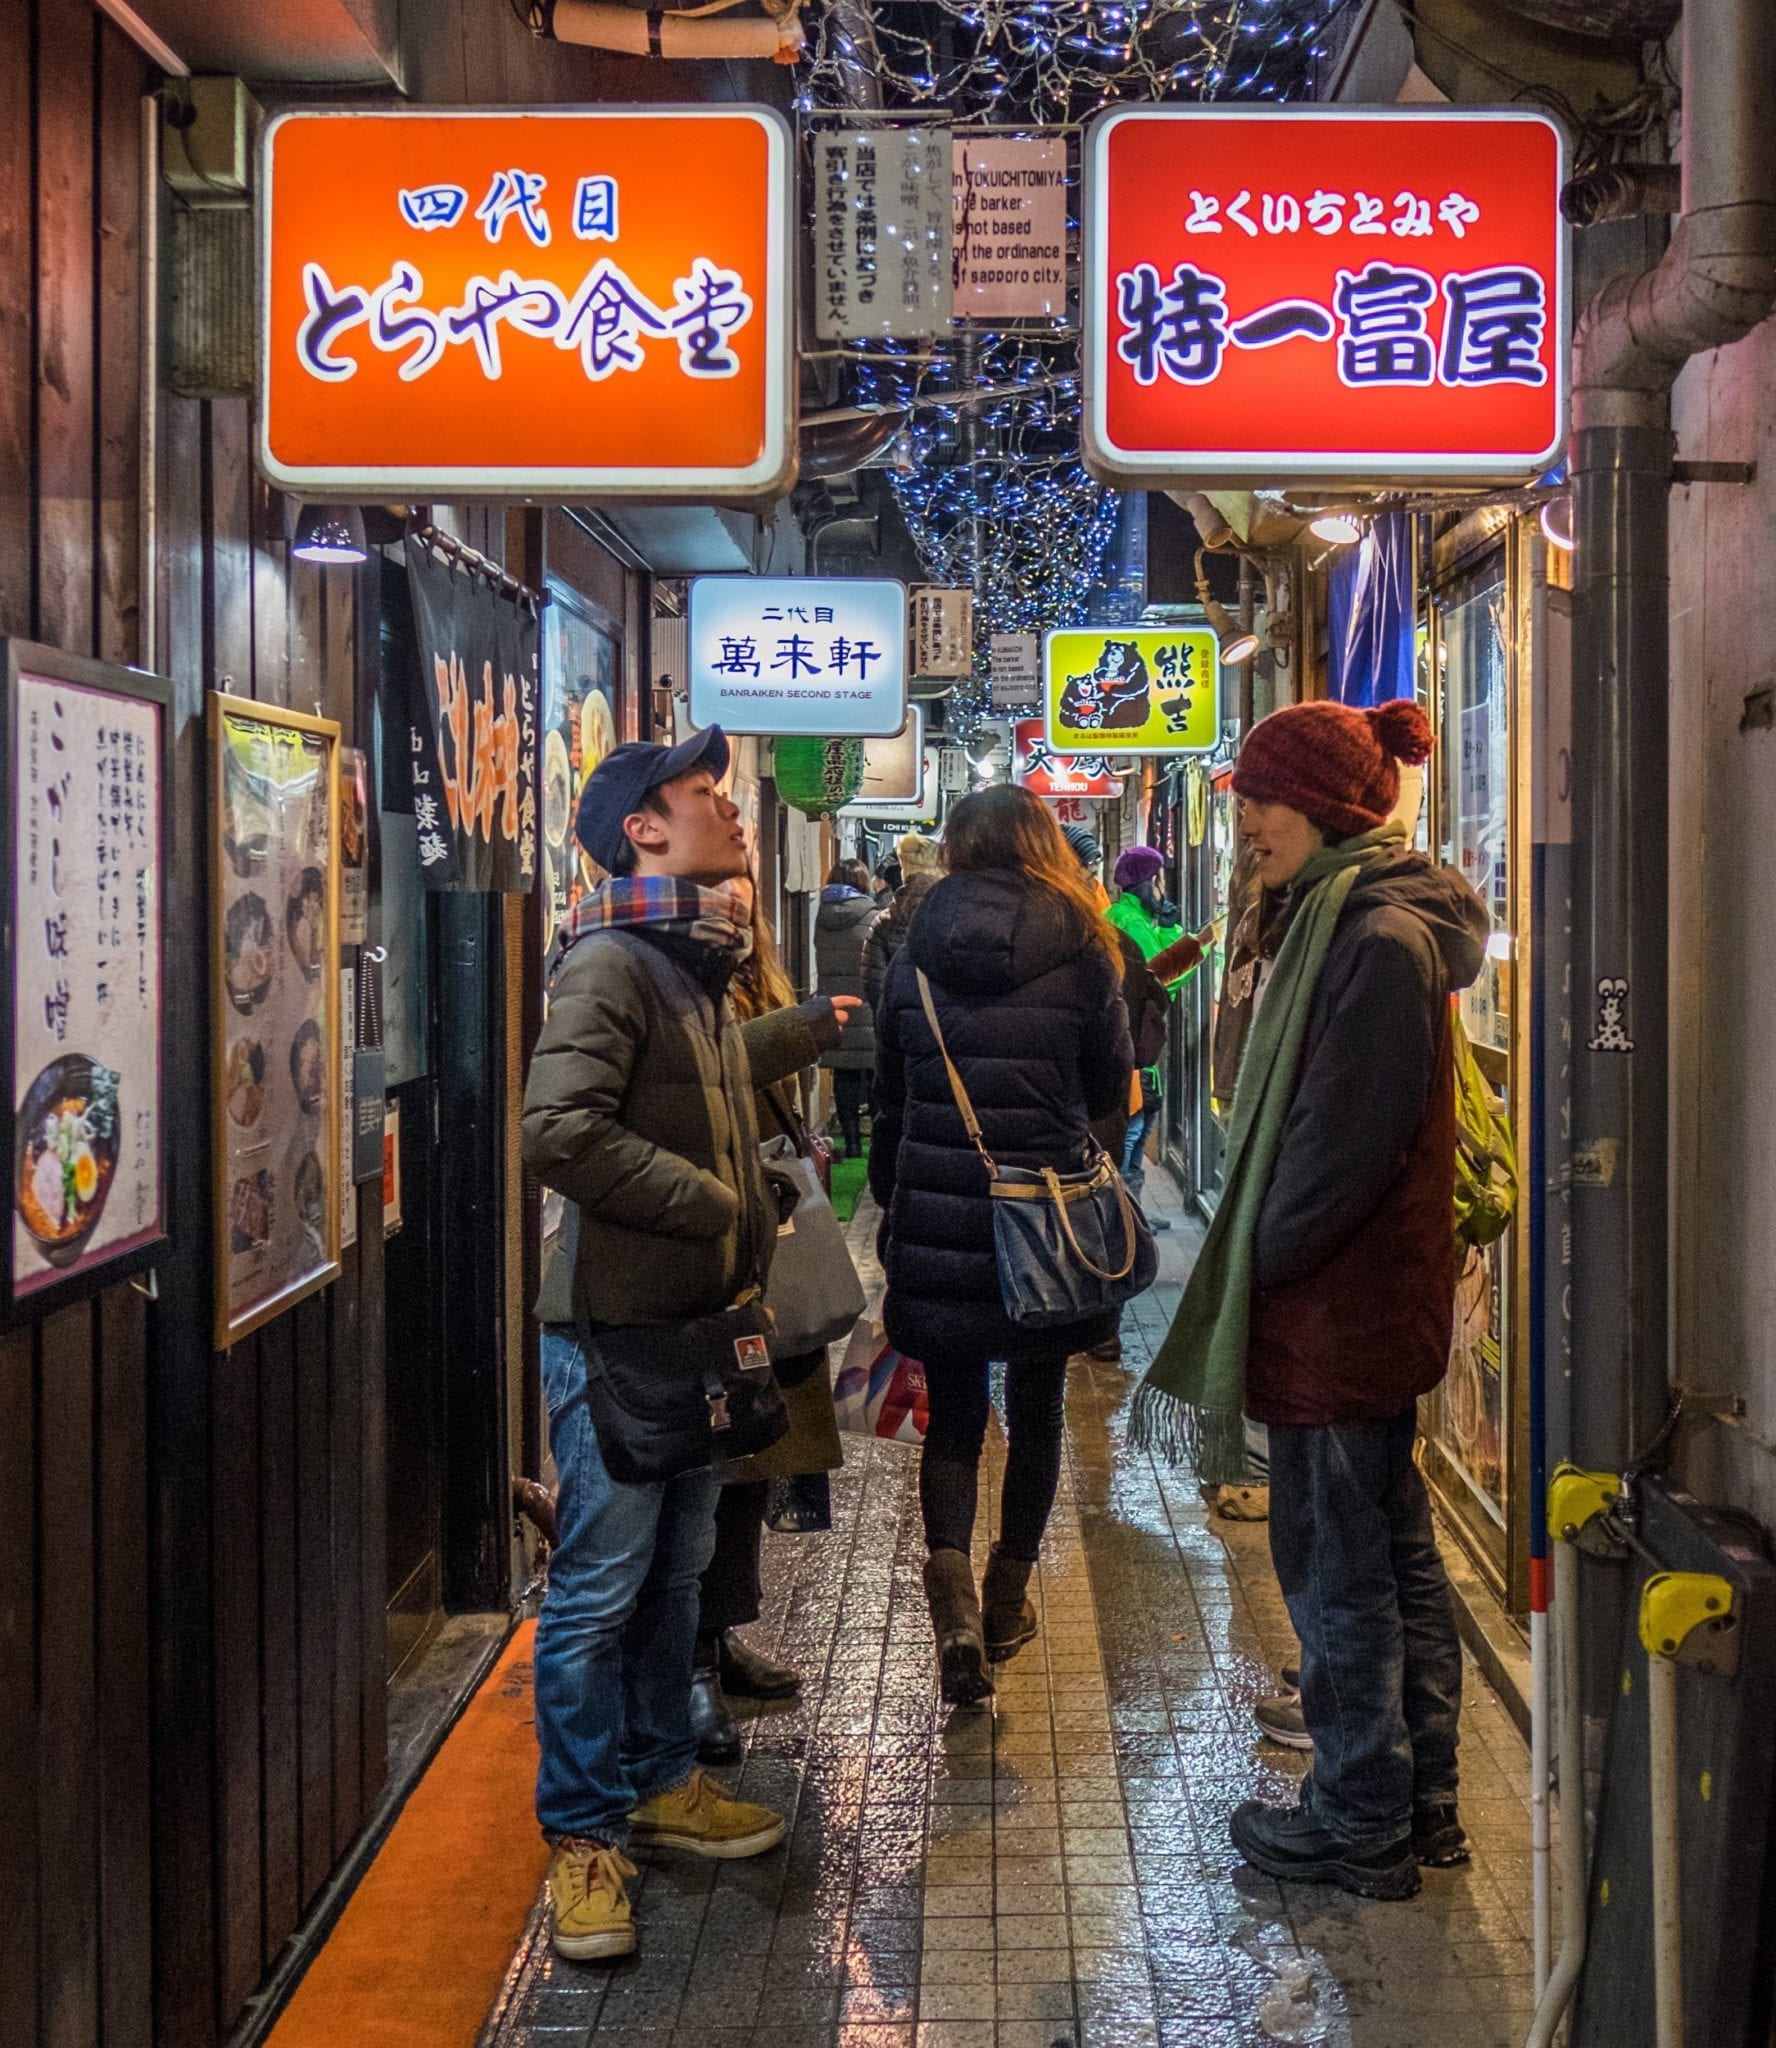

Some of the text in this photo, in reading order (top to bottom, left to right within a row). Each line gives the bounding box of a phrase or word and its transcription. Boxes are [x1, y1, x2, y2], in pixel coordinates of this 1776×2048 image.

[952, 171, 1064, 187] In TOKUICHITOMIYA
[399, 169, 620, 246] 四代目
[981, 195, 1022, 211] barker
[1185, 190, 1480, 238] とくいちとみや
[952, 219, 1031, 235] is not based
[952, 243, 1060, 260] on the ordinance
[971, 269, 1029, 284] sapporo
[1033, 267, 1063, 284] city.
[296, 258, 753, 381] とらや食堂
[1117, 261, 1547, 387] 特一富屋
[762, 607, 834, 624] 二代目
[711, 633, 882, 680] 萬来軒
[1200, 649, 1210, 689] 登録商標
[720, 688, 872, 699] BANRAIKEN SECOND STAGE
[1154, 642, 1195, 733] 熊吉
[519, 673, 536, 875] とらや食堂
